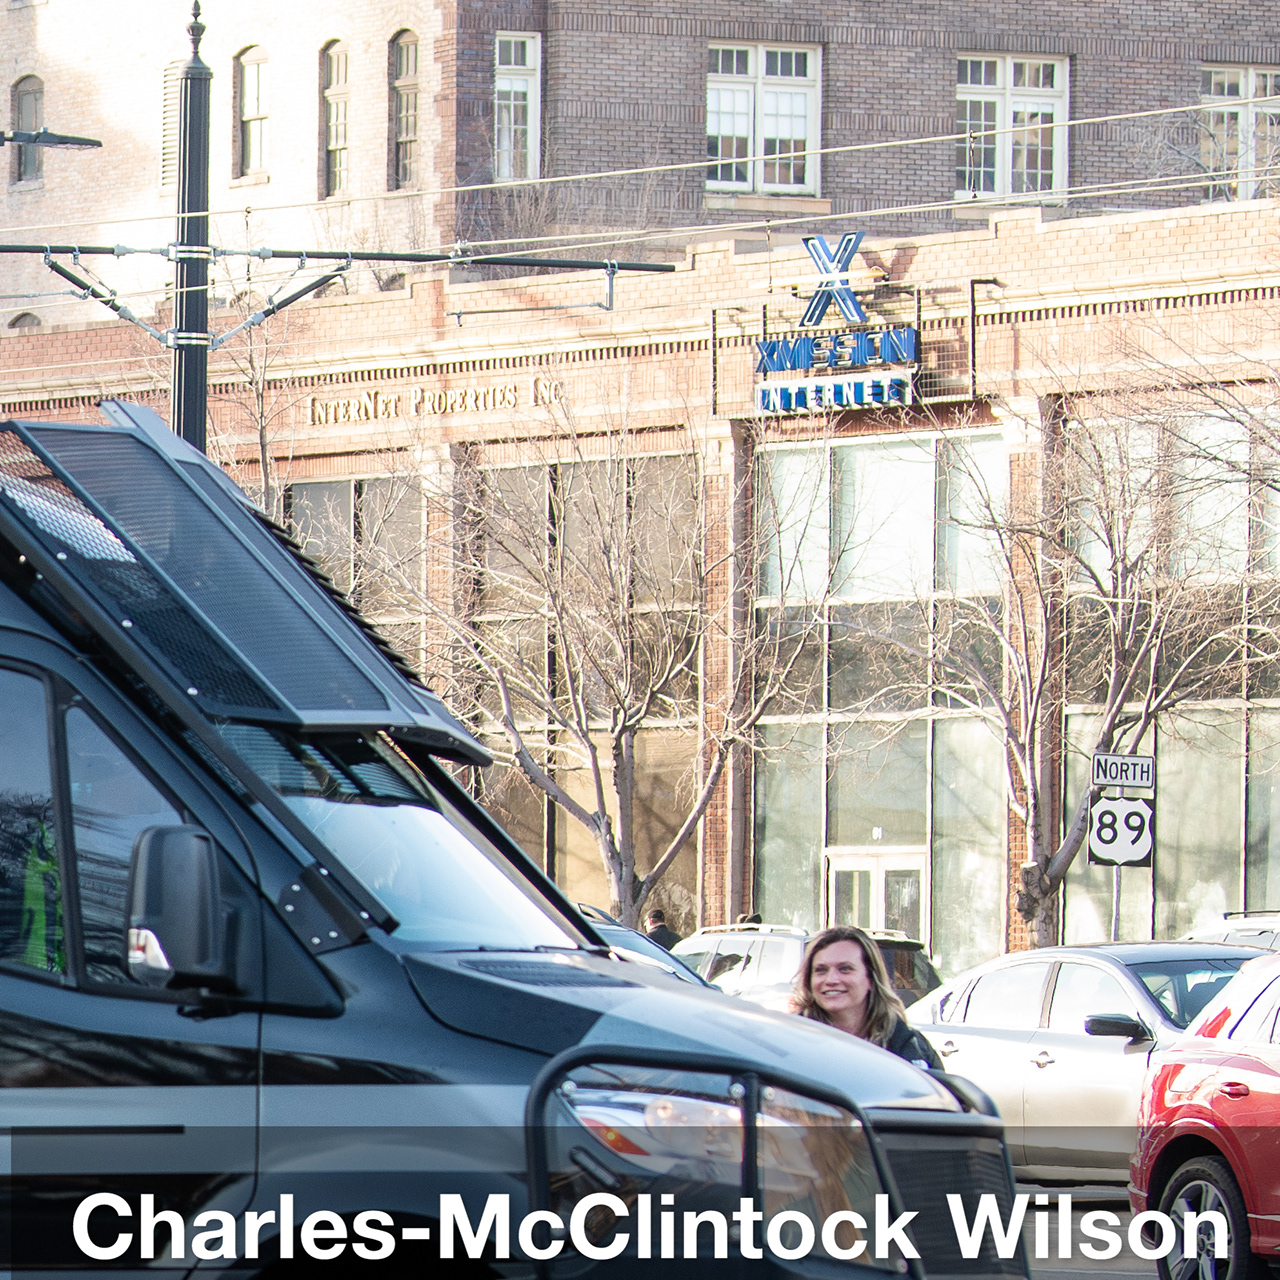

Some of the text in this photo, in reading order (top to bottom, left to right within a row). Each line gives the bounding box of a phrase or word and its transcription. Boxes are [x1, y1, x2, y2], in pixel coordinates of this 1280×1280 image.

[799, 231, 868, 327] X
[755, 327, 916, 373] XMISSION
[755, 378, 892, 412] INTERNET
[1096, 758, 1150, 781] NORTH
[1096, 809, 1146, 846] 89
